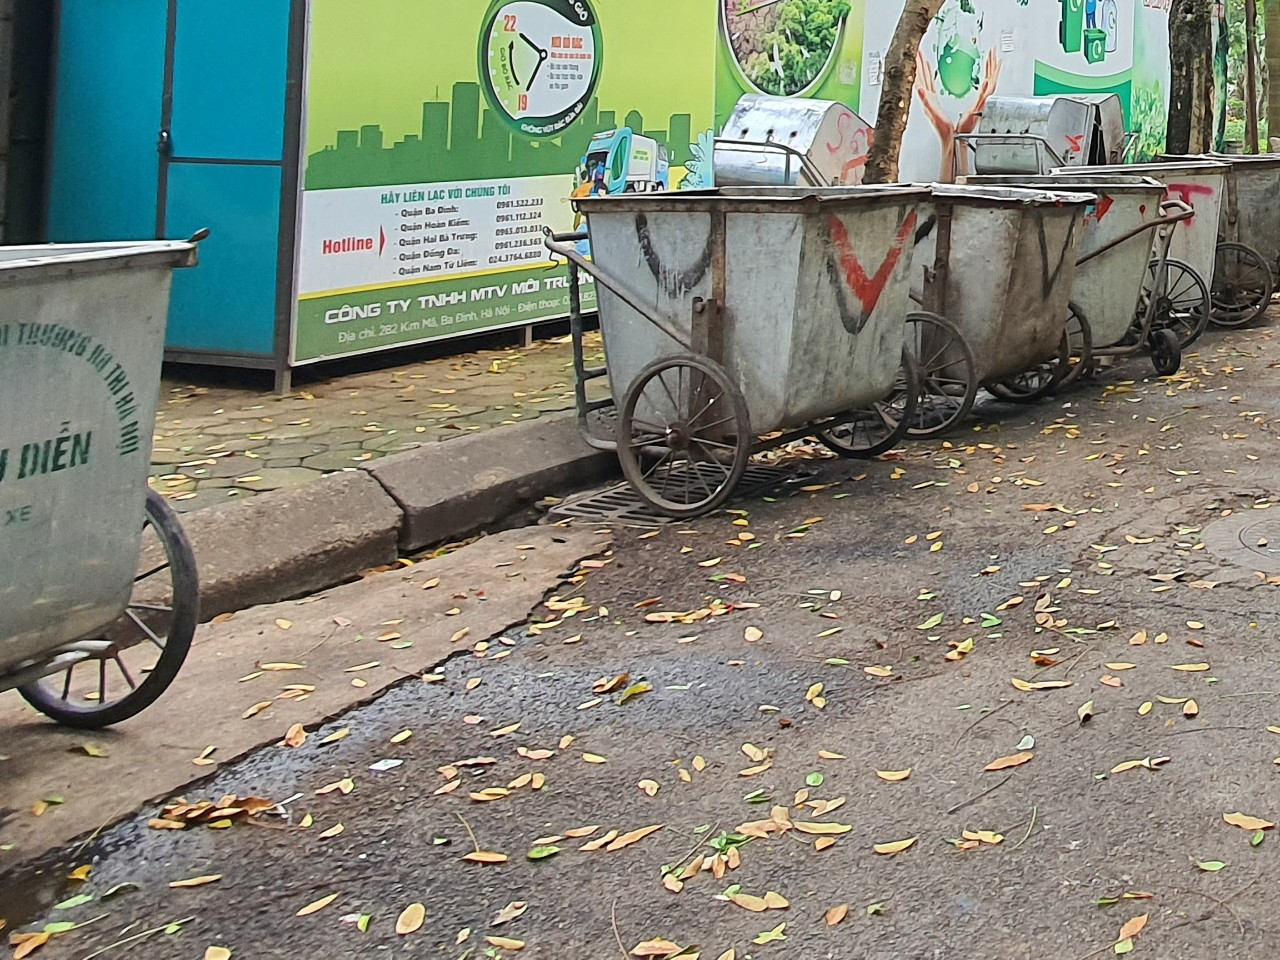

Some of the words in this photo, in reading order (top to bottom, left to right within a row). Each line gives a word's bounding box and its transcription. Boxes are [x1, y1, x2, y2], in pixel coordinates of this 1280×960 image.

[504, 15, 516, 32] 22
[518, 94, 527, 111] 19
[403, 189, 425, 203] LIÊN
[428, 190, 445, 203] LẠC
[448, 186, 462, 199] VỚI
[465, 185, 495, 198] CHÚNG
[498, 185, 511, 196] TÔI
[425, 221, 446, 229] Hoàn
[322, 237, 373, 254] Hotline
[423, 235, 437, 244] Hai
[440, 234, 449, 242] Bà
[444, 261, 454, 269] Từ
[325, 304, 381, 324] CÔNG
[386, 299, 411, 314] TY
[417, 291, 467, 309] TNHH
[470, 284, 508, 302] MTV
[512, 278, 540, 295] MÔI
[338, 332, 356, 344] Địa
[379, 324, 398, 336] 282
[401, 322, 420, 332] Kim
[441, 315, 453, 325] Ba
[481, 308, 493, 319] Hà
[495, 305, 511, 318] Nội
[518, 302, 538, 314] Điện
[115, 391, 140, 421] HÀ
[18, 421, 92, 479] DIỄN
[6, 505, 31, 526] XE
